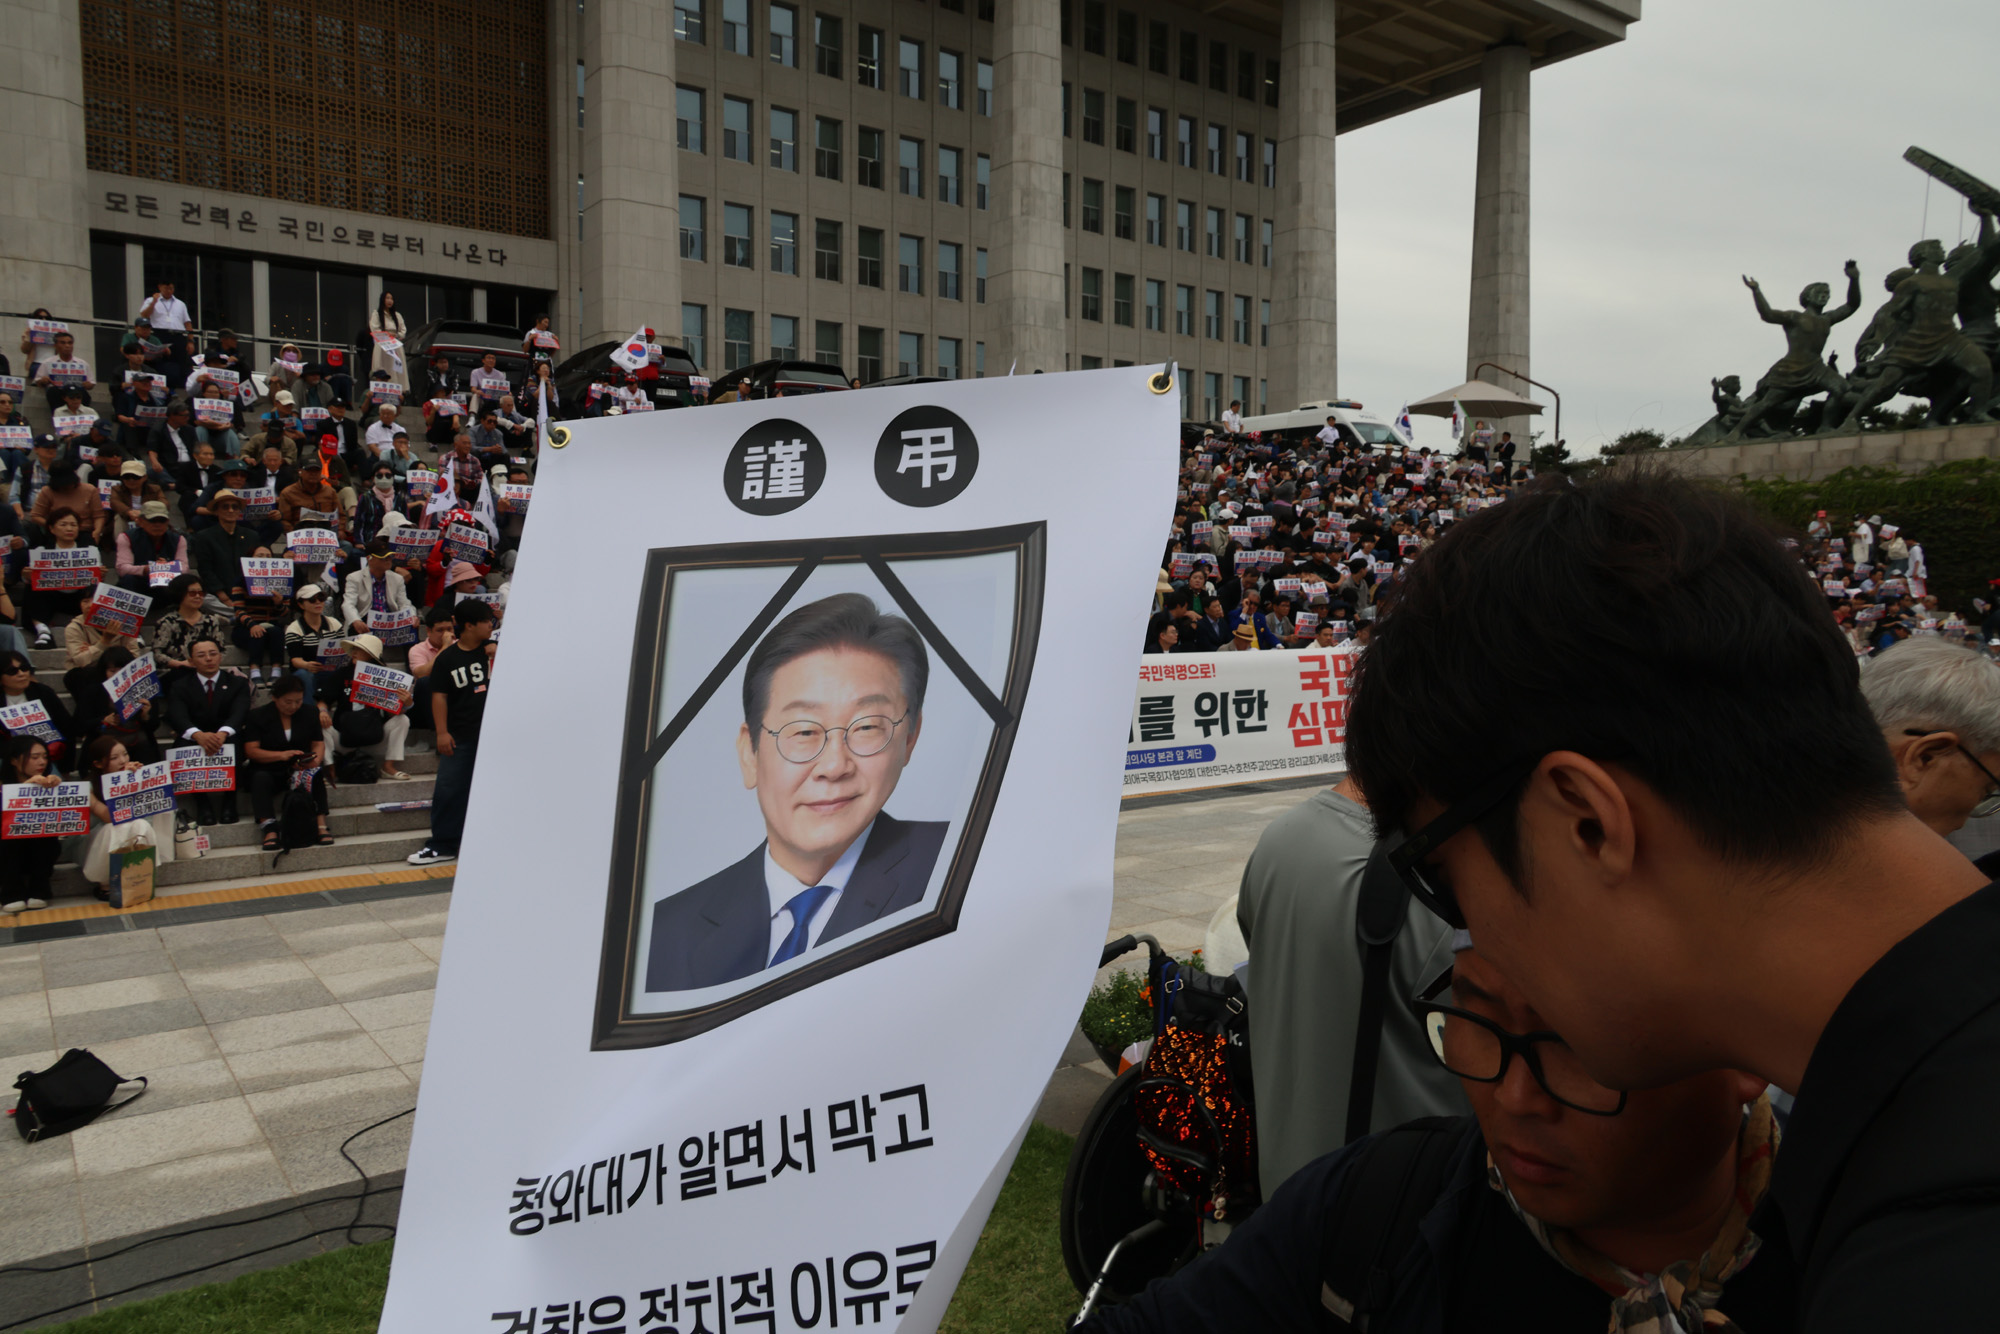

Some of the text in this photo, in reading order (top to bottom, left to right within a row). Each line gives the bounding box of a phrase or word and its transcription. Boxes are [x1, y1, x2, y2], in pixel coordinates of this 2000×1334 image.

[105, 192, 508, 266] 모든 권력은 국민으로부터 나온다
[742, 427, 957, 500] 謹 弔
[451, 663, 491, 689] US
[1139, 663, 1216, 682] 국민혁명으로!
[1129, 695, 1176, 743] 를
[1194, 689, 1268, 739] 위한
[185, 759, 203, 769] 부터
[204, 756, 233, 768] 받아라
[1157, 751, 1174, 763] 본관
[1175, 750, 1184, 761] 앞
[1186, 748, 1203, 760] 계단
[173, 769, 228, 783] 국민합의 없는
[193, 778, 232, 791] 반대한다
[18, 784, 80, 797] 피하지 말고
[8, 796, 89, 809] 재판 부터 받아라
[114, 789, 164, 811] 518 유공자
[133, 799, 173, 817] 공개하라
[14, 810, 82, 824] 국민합의 없는
[8, 820, 87, 836] 개헌은 반대한다
[508, 1083, 934, 1236] 청와대가 알면서 막고
[639, 1267, 776, 1334] 정치적
